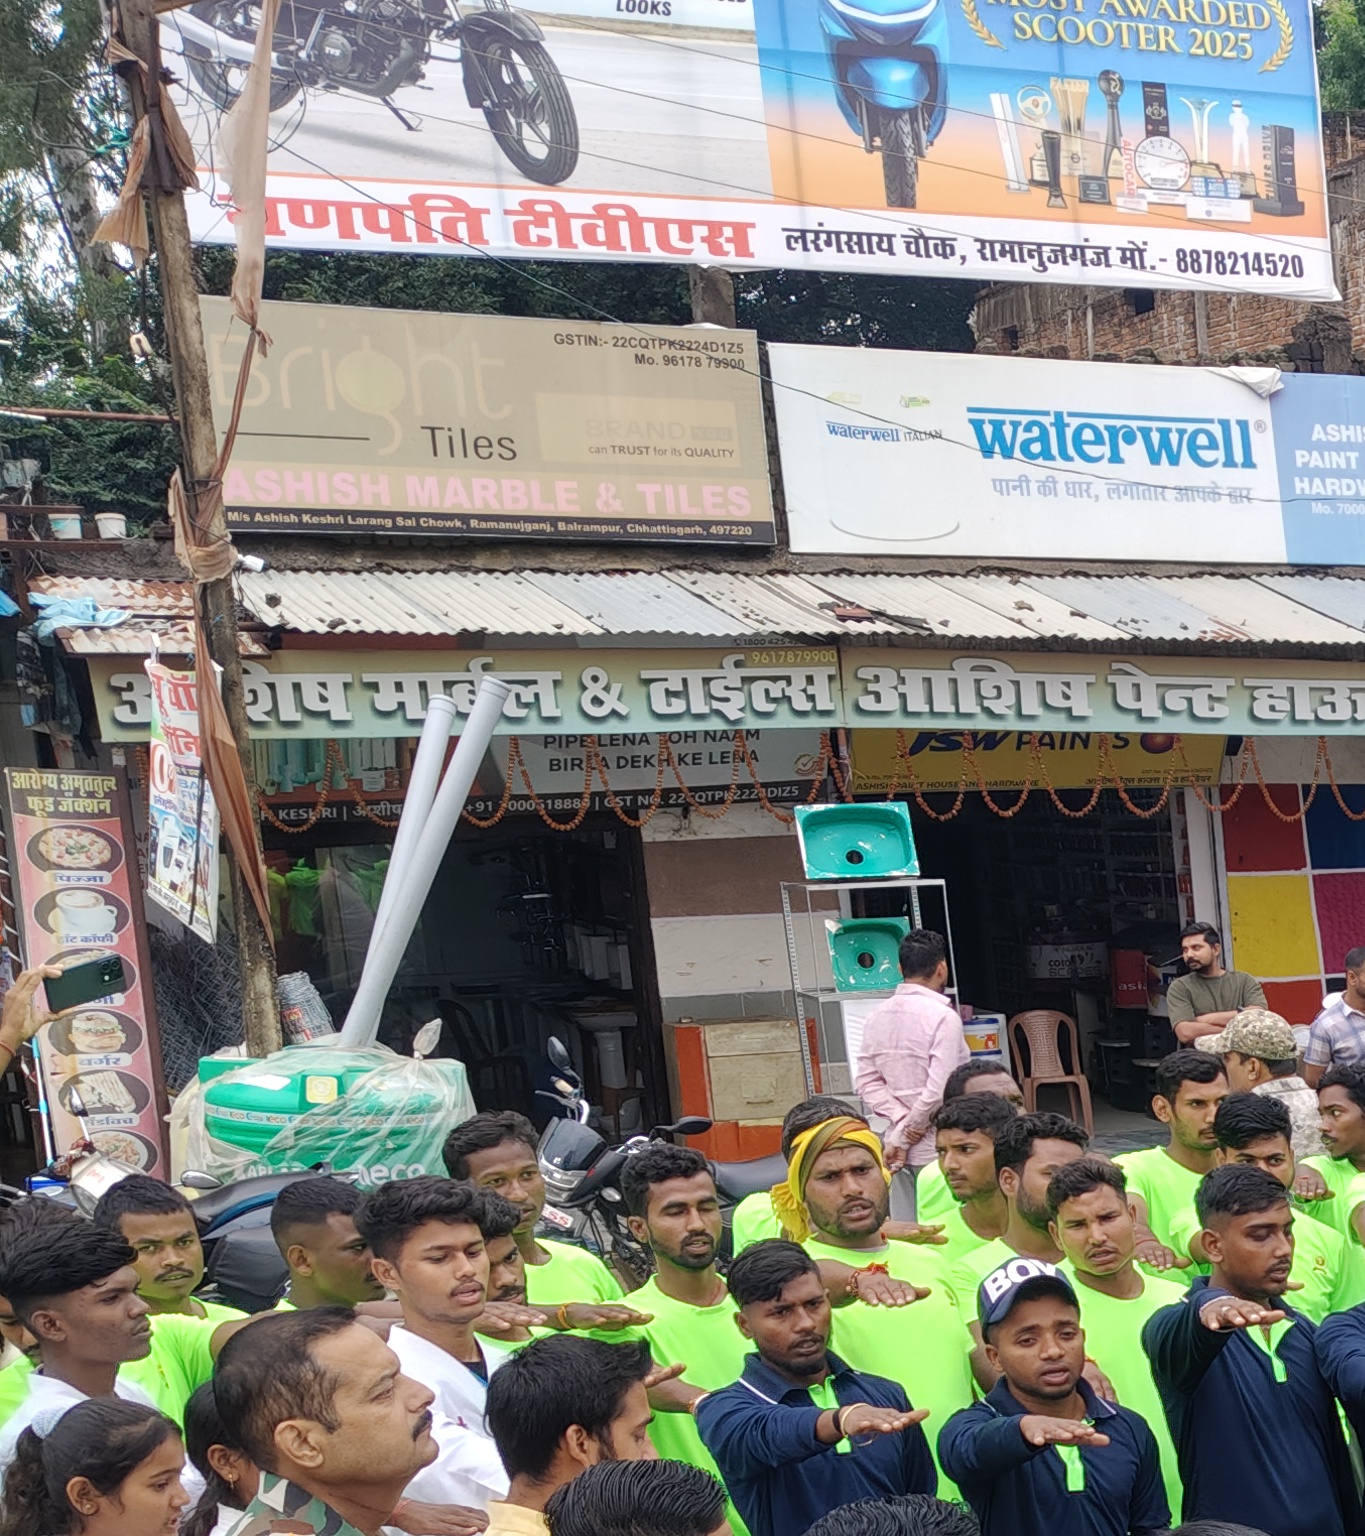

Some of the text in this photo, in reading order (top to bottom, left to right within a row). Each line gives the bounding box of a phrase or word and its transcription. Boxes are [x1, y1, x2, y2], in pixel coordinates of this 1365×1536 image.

[615, 0, 672, 17] LOOKS
[1098, 0, 1272, 30] AWARDED
[1013, 11, 1254, 60] SCOOTER 2025
[503, 199, 756, 258] टीवीएस
[781, 222, 897, 257] लरंगसाय
[903, 228, 967, 266] चौक,
[974, 238, 1112, 274] रामानुजगंज
[1175, 247, 1304, 279] 8878214520
[634, 353, 659, 365] Mo.
[662, 354, 702, 367] 96178
[420, 425, 518, 461] Tiles
[826, 420, 901, 442] waterwell
[966, 406, 1258, 470] waterwell
[589, 445, 735, 459] can TRUST for its QUALITY
[1295, 450, 1359, 469] PAINT
[223, 468, 752, 517] ASHISH MARBLE & TILES
[991, 476, 1031, 498] पानी
[1036, 477, 1059, 499] की
[1106, 482, 1167, 502] लगातार
[253, 512, 299, 523] Ashish
[302, 513, 344, 525] Keshri
[347, 514, 393, 528] Larang
[419, 517, 467, 530] Chowk,
[470, 518, 555, 533] Ramanujganj,
[558, 521, 623, 535] Balrampur,
[626, 523, 707, 536] Chhattisgarh,
[709, 525, 753, 536] 497220
[580, 666, 630, 718] &
[640, 652, 837, 722] टाईल्स
[857, 657, 1096, 717] आशिष
[1107, 662, 1235, 719] पेन्ट
[602, 732, 650, 747] LENA
[1016, 731, 1131, 751] PAINS
[677, 752, 702, 766] KE
[12, 768, 58, 790] आरोग्य
[26, 795, 55, 817] फूड
[983, 1258, 1056, 1304] BOY
